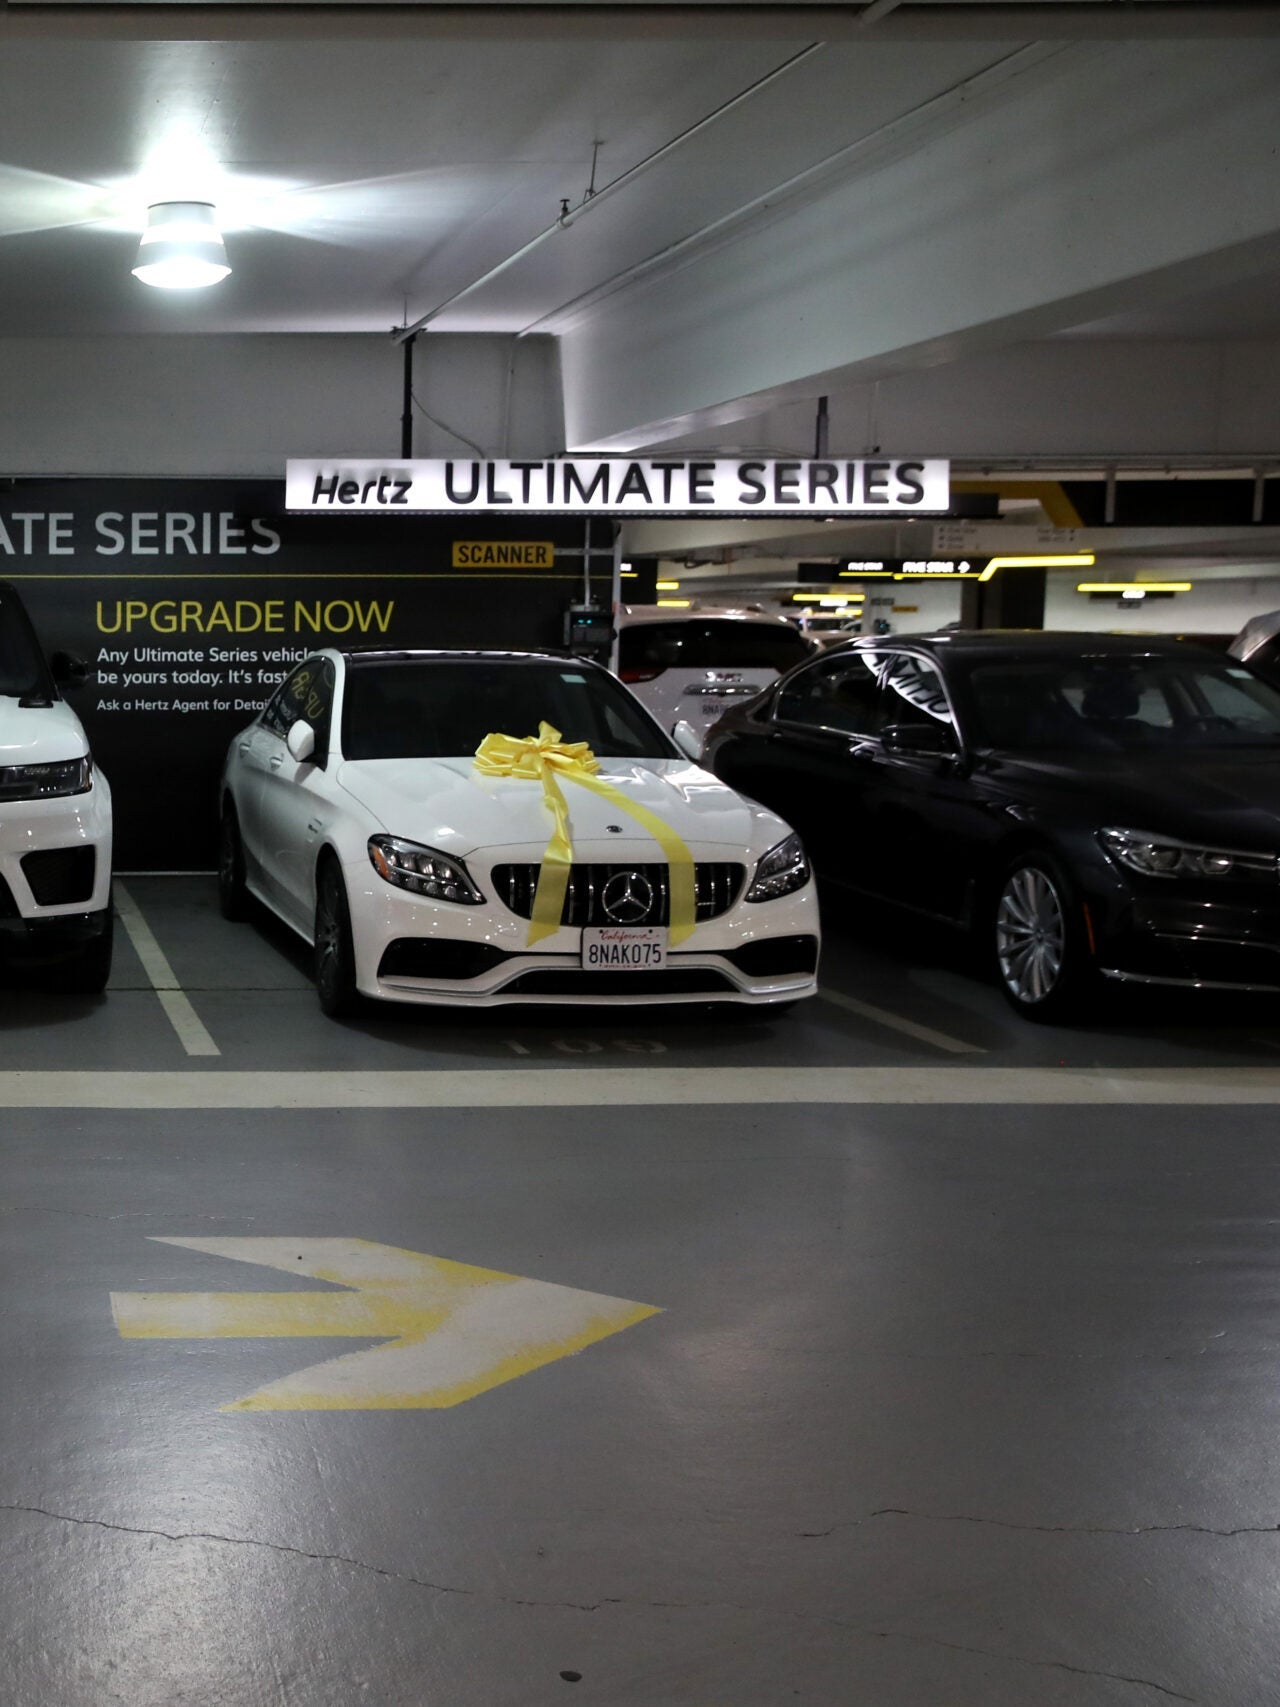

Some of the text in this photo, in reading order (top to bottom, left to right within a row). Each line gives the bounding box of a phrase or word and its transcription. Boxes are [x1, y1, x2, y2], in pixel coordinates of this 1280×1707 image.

[312, 462, 925, 505] Hertz ULTIMATE SERIES
[95, 511, 281, 556] SERIES
[458, 544, 547, 565] SCANNER
[96, 600, 394, 633] UPGRADE NOW
[97, 648, 128, 665] Any
[133, 647, 204, 662] Ultimate
[209, 647, 258, 662] Series
[97, 669, 119, 684] be
[122, 672, 168, 688] yours
[171, 669, 223, 688] today.
[228, 669, 253, 684] It's
[96, 699, 120, 711] Ask
[122, 702, 132, 711] a
[134, 699, 169, 711] Hertz
[172, 699, 210, 714] Agent
[213, 698, 231, 711] for
[588, 944, 662, 964] 8NAK075
